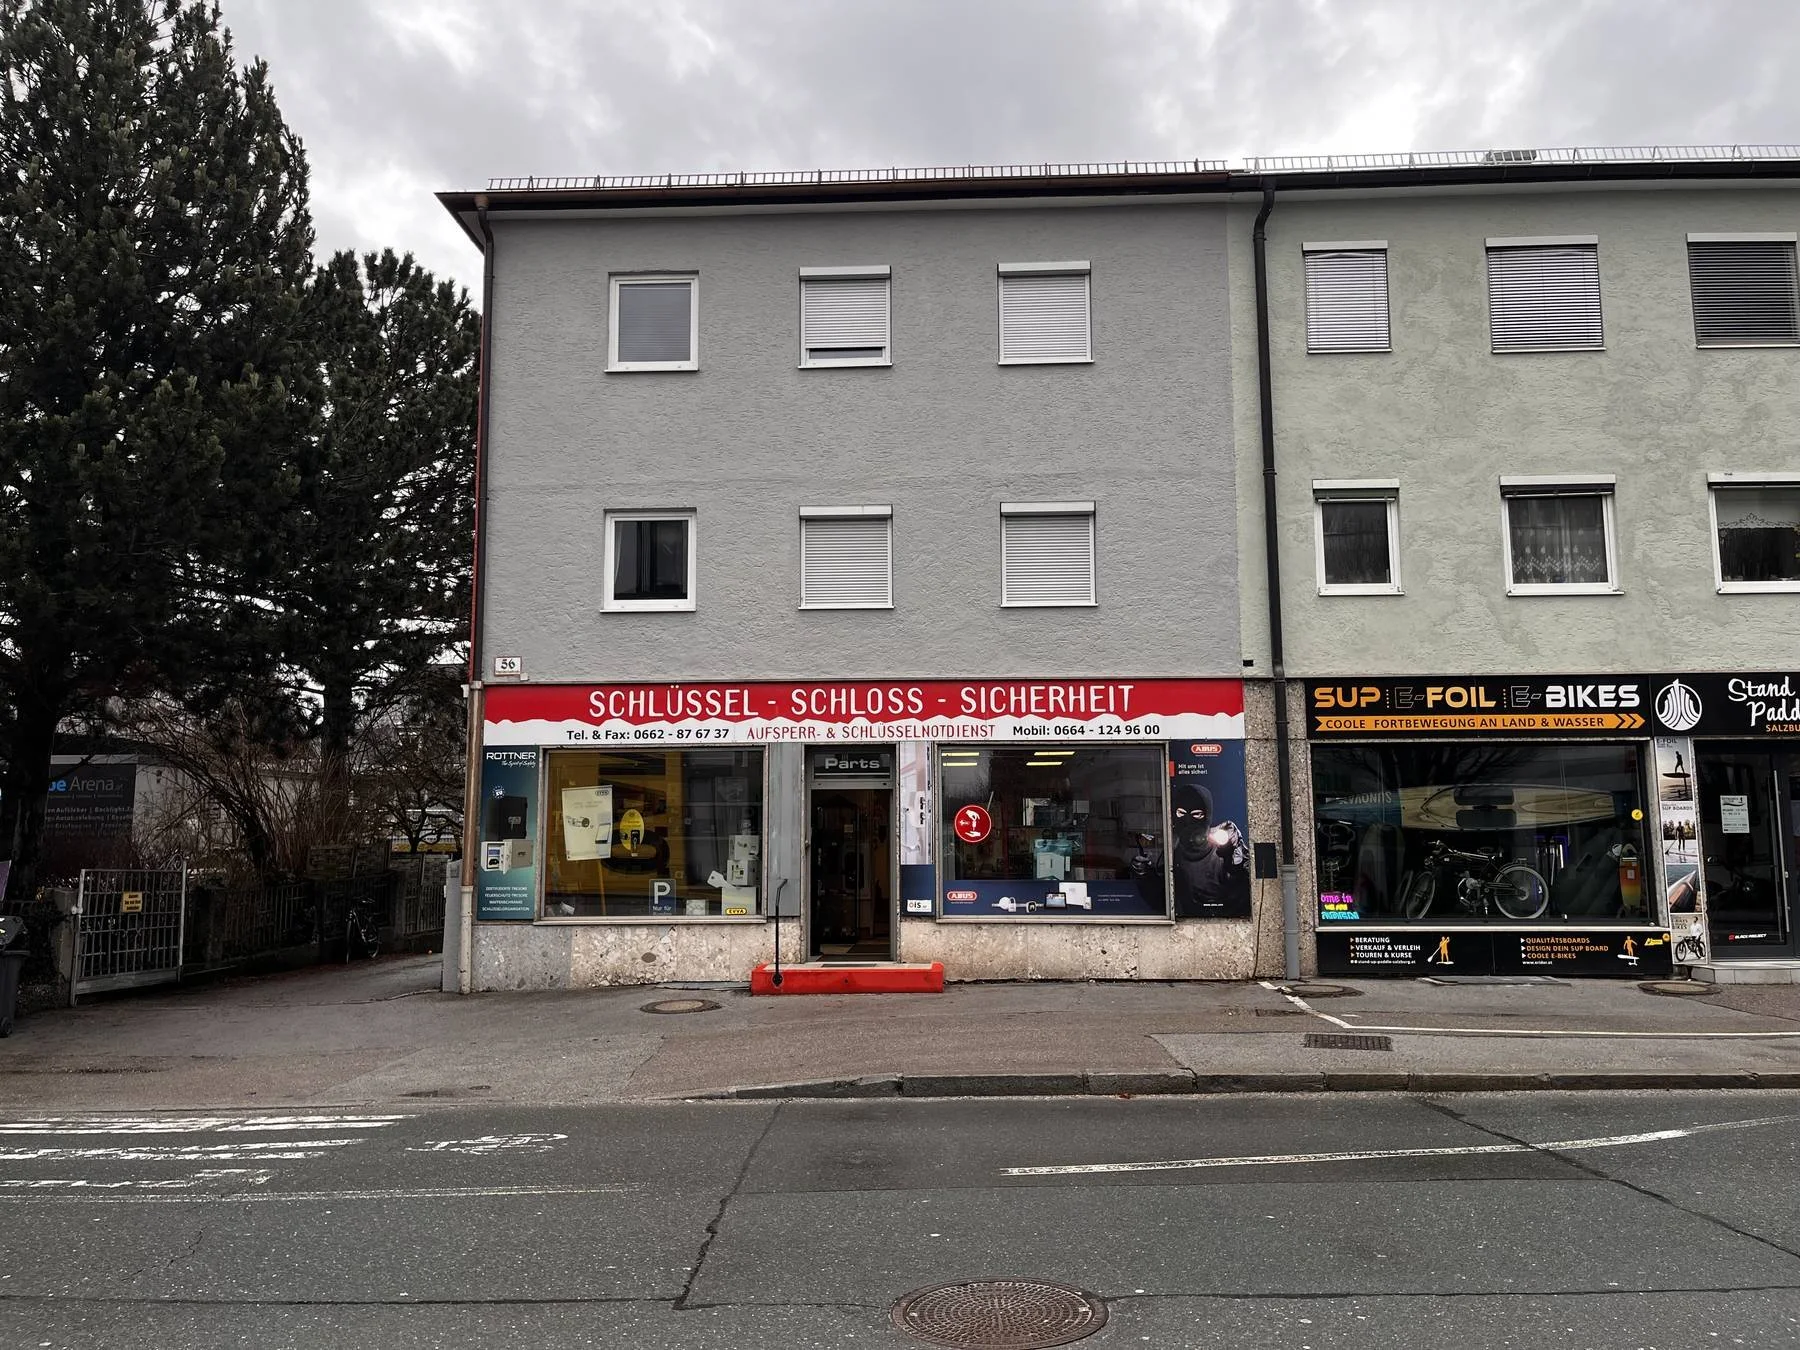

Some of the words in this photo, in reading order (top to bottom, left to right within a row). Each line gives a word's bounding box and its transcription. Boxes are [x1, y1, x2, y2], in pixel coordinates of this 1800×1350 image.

[500, 658, 516, 670] 56
[1728, 676, 1796, 702] Stand
[589, 685, 759, 717] SCHLÜSSEL
[791, 687, 923, 715] SCHLOSS
[960, 685, 1134, 713] SICHERHEIT
[1314, 686, 1381, 708] SUP
[1394, 686, 1496, 708] E-FOIL
[1510, 685, 1640, 708] E-BIKES
[1326, 719, 1366, 729] COOLE
[1374, 718, 1475, 729] FORTBEWEGUNG
[1480, 718, 1497, 728] AN
[1502, 718, 1536, 728] LAND
[1541, 717, 1549, 727] &
[1554, 717, 1605, 727] WASSER
[567, 730, 588, 740] Tel.
[592, 730, 601, 740] &
[605, 729, 630, 740] Fax:
[634, 729, 664, 740] 0662
[676, 729, 692, 739] 87
[695, 729, 712, 739] 67
[714, 728, 730, 739] 37
[747, 726, 821, 740] AUFSPERR-
[826, 727, 836, 739] &
[842, 723, 996, 740] SCHLÜSSELNOTDIENST
[1013, 725, 1050, 736] Mobil:
[1054, 725, 1085, 736] 0664
[1098, 725, 1121, 735] 124
[1125, 725, 1141, 735] 96
[1144, 725, 1160, 735] 00
[486, 751, 537, 760] ROTTNER
[824, 757, 880, 769] Parts
[69, 775, 114, 792] Arena
[654, 882, 671, 904] P
[1321, 894, 1340, 903] ome
